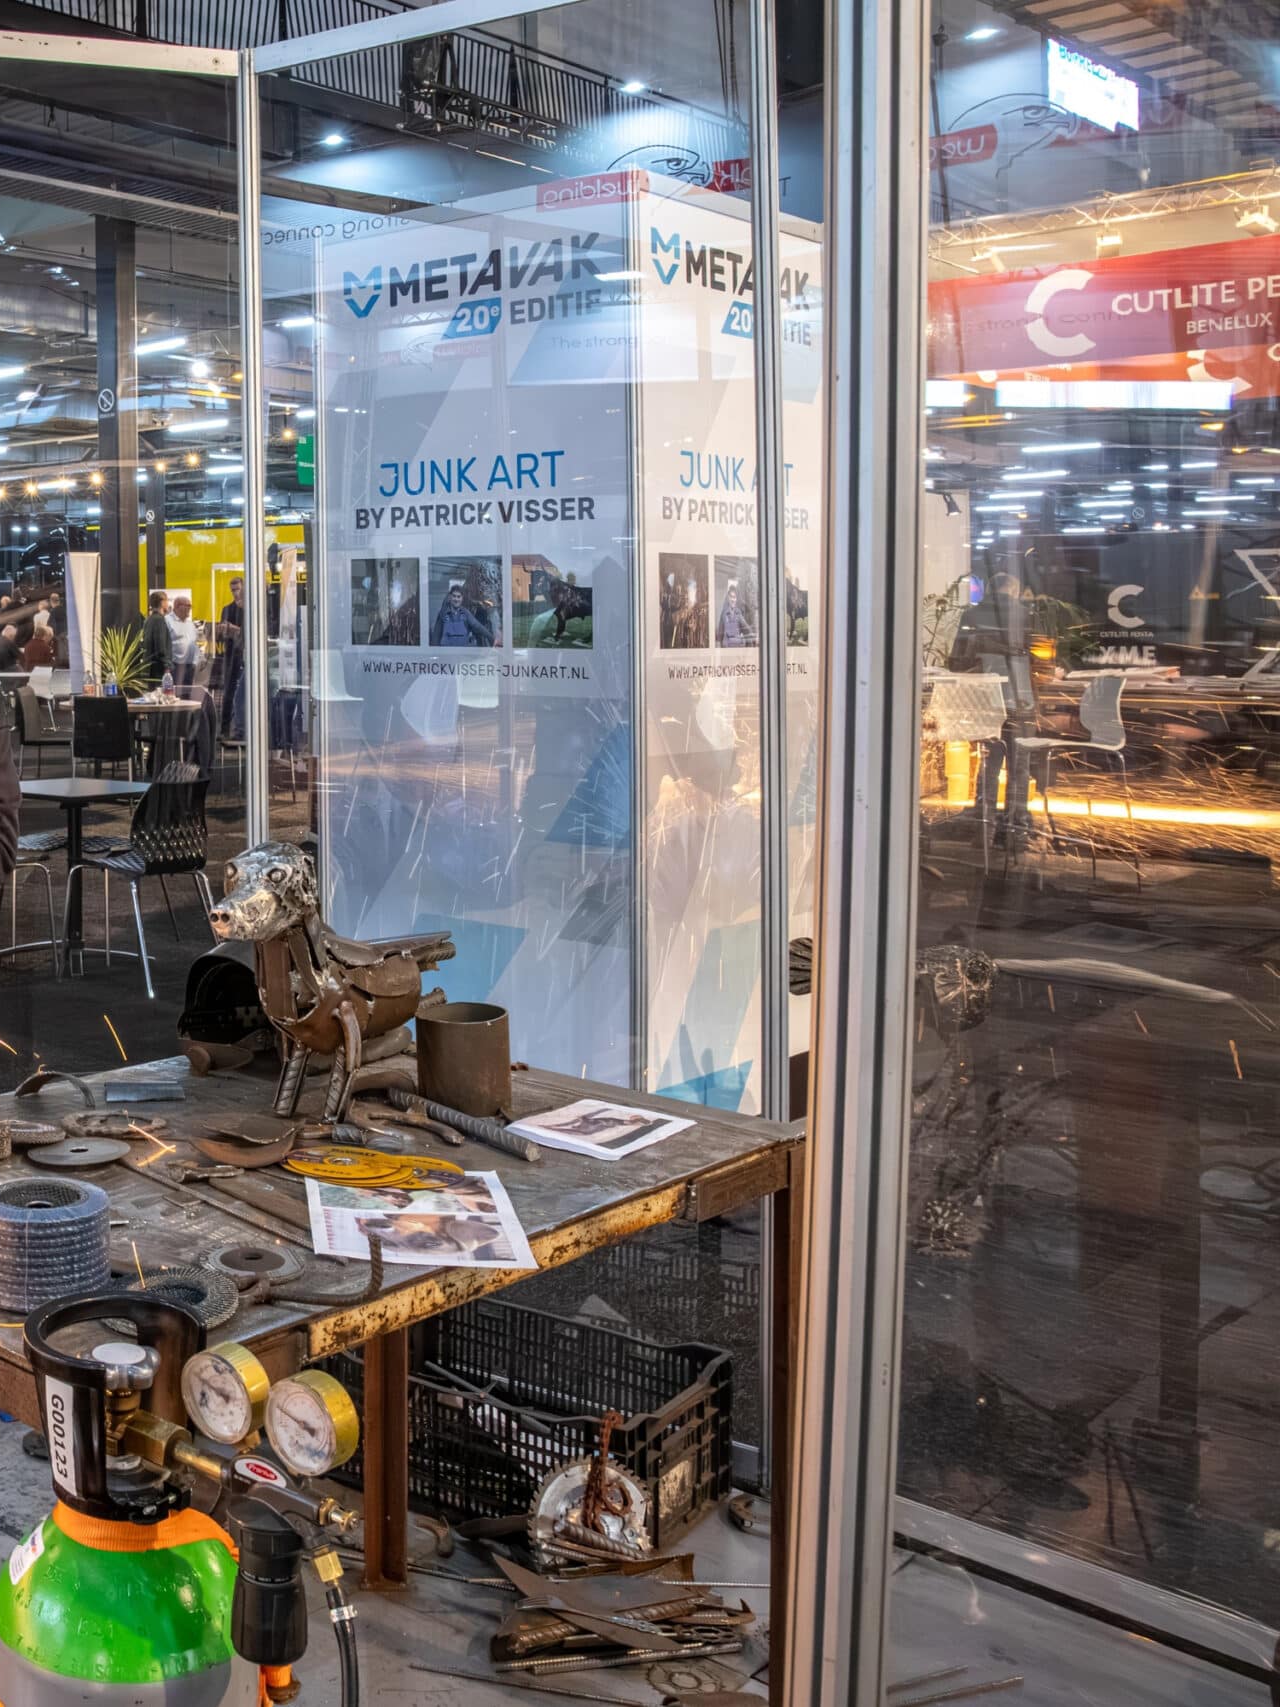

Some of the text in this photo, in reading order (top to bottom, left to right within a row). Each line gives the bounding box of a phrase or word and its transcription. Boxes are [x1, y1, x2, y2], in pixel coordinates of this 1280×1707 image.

[389, 232, 602, 308] METAVAK
[685, 240, 809, 311] METAAK
[510, 289, 602, 325] EDITIE
[1111, 280, 1236, 316] CUTLITE
[1186, 312, 1272, 335] BENELUX
[379, 450, 565, 497] JUNK ART
[680, 450, 746, 492] JUNK
[355, 496, 595, 530] BY PATRICK VISSER
[662, 496, 684, 520] BY
[688, 498, 755, 526] PATRICK
[363, 661, 590, 680] WWW.PATRICKVISSER-JUNKART.NL
